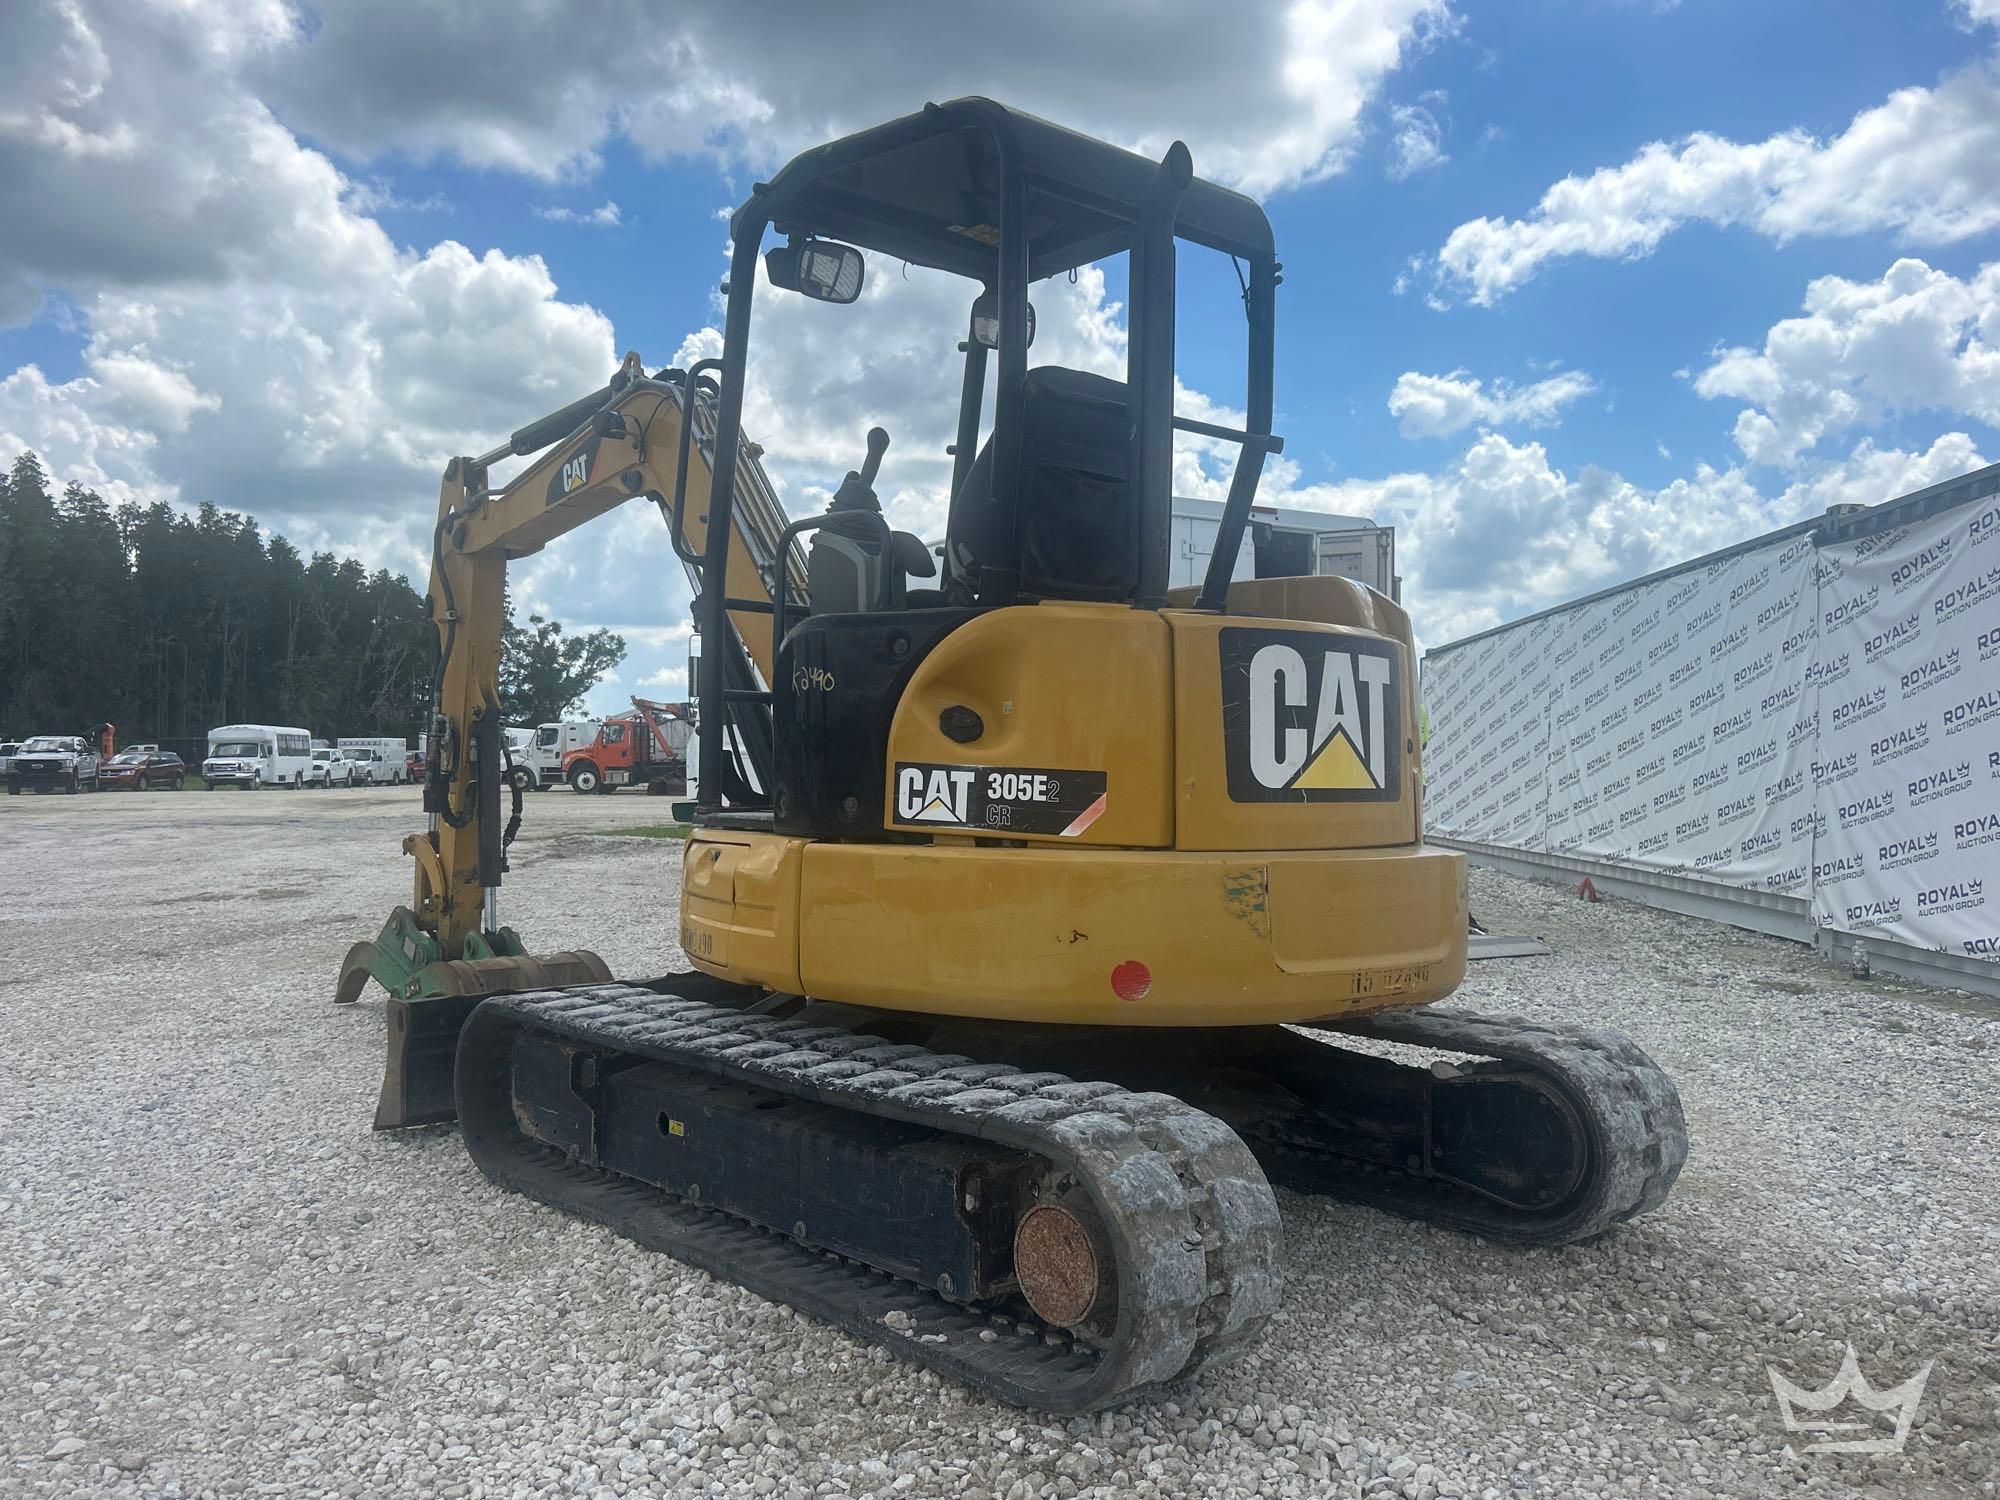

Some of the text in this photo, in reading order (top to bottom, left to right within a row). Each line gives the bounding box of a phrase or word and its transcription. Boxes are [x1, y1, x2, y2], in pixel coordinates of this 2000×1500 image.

[563, 453, 587, 492] CAT
[1891, 547, 1938, 586] ROYAL
[1895, 554, 1952, 595] AUCTION GROUP
[1667, 587, 1692, 610] ROYAL
[1730, 573, 1761, 602] ROYAL
[1935, 577, 1987, 615] ROYAL
[1687, 608, 1713, 633] ROYAL
[1758, 597, 1790, 625] ROYAL
[1826, 594, 1866, 626] ROYAL
[1827, 600, 1879, 634] AUCTION GROUP
[1936, 602, 1971, 625] AUCTION
[1583, 622, 1601, 642] ROYAL
[1632, 614, 1652, 638] ROYAL
[1649, 638, 1672, 661] ROYAL
[1710, 631, 1740, 656] ROYAL
[1865, 623, 1908, 656] ROYAL
[1866, 630, 1920, 665] AUCTION GROUP
[1600, 641, 1619, 662] ROYAL
[1570, 666, 1589, 684] ROYAL
[1615, 664, 1638, 685] ROYAL
[1670, 661, 1695, 683] ROYAL
[1734, 659, 1764, 684] ROYAL
[1830, 668, 1850, 685] GROUP
[1901, 656, 1946, 690] ROYAL
[1902, 665, 1961, 700] AUCTION GROUP
[1584, 687, 1604, 707] ROYAL
[1634, 686, 1656, 708] ROYAL
[1690, 688, 1716, 710] ROYAL
[1761, 686, 1794, 712] ROYAL
[1833, 694, 1873, 722] ROYAL
[1250, 644, 1390, 788] CAT
[1602, 711, 1621, 729] ROYAL
[1834, 702, 1886, 731] AUCTION GROUP
[1944, 693, 1997, 726] ROYAL
[1651, 714, 1676, 733] ROYAL
[1713, 714, 1744, 737] ROYAL
[1945, 715, 1981, 737] AUCTION
[1571, 730, 1591, 747] ROYAL
[1618, 736, 1639, 753] ROYAL
[1673, 740, 1698, 759] ROYAL
[1871, 728, 1915, 757] ROYAL
[1587, 754, 1605, 771] ROYAL
[1738, 746, 1768, 768] ROYAL
[1872, 738, 1929, 767] AUCTION GROUP
[1559, 772, 1576, 787] ROYAL
[1636, 762, 1658, 779] ROYAL
[1693, 766, 1719, 789] ROYAL
[1738, 762, 1759, 776] AUCTION
[1836, 767, 1858, 782] GROUP
[1604, 779, 1624, 796] ROYAL
[1766, 777, 1795, 799] ROYAL
[1908, 768, 1956, 797] ROYAL
[899, 768, 975, 822] CAT
[1574, 796, 1592, 811] ROYAL
[1654, 789, 1679, 807] ROYAL
[1910, 780, 1972, 808] AUCTION GROUP
[986, 804, 1011, 825] CR
[1620, 806, 1641, 822] ROYAL
[1718, 799, 1747, 819] ROYAL
[1839, 795, 1882, 821] ROYAL
[1841, 807, 1895, 830] AUCTION GROUP
[1588, 822, 1608, 837] ROYAL
[1676, 818, 1702, 836] ROYAL
[1639, 834, 1662, 851] ROYAL
[1741, 832, 1772, 853] ROYAL
[1879, 837, 1925, 861] ROYAL
[1957, 834, 1993, 850] AUCTION
[1695, 851, 1724, 868] ROYAL
[1814, 859, 1853, 878] ROYAL
[1880, 849, 1939, 871] AUCTION GROUP
[1767, 868, 1801, 888] ROYAL
[1816, 869, 1864, 888] AUCTION GROUP
[1918, 884, 1969, 906] ROYAL
[1847, 901, 1889, 922] ROYAL
[1918, 898, 1984, 918] AUCTION GROUP
[1849, 914, 1902, 930] AUCTION GROUP
